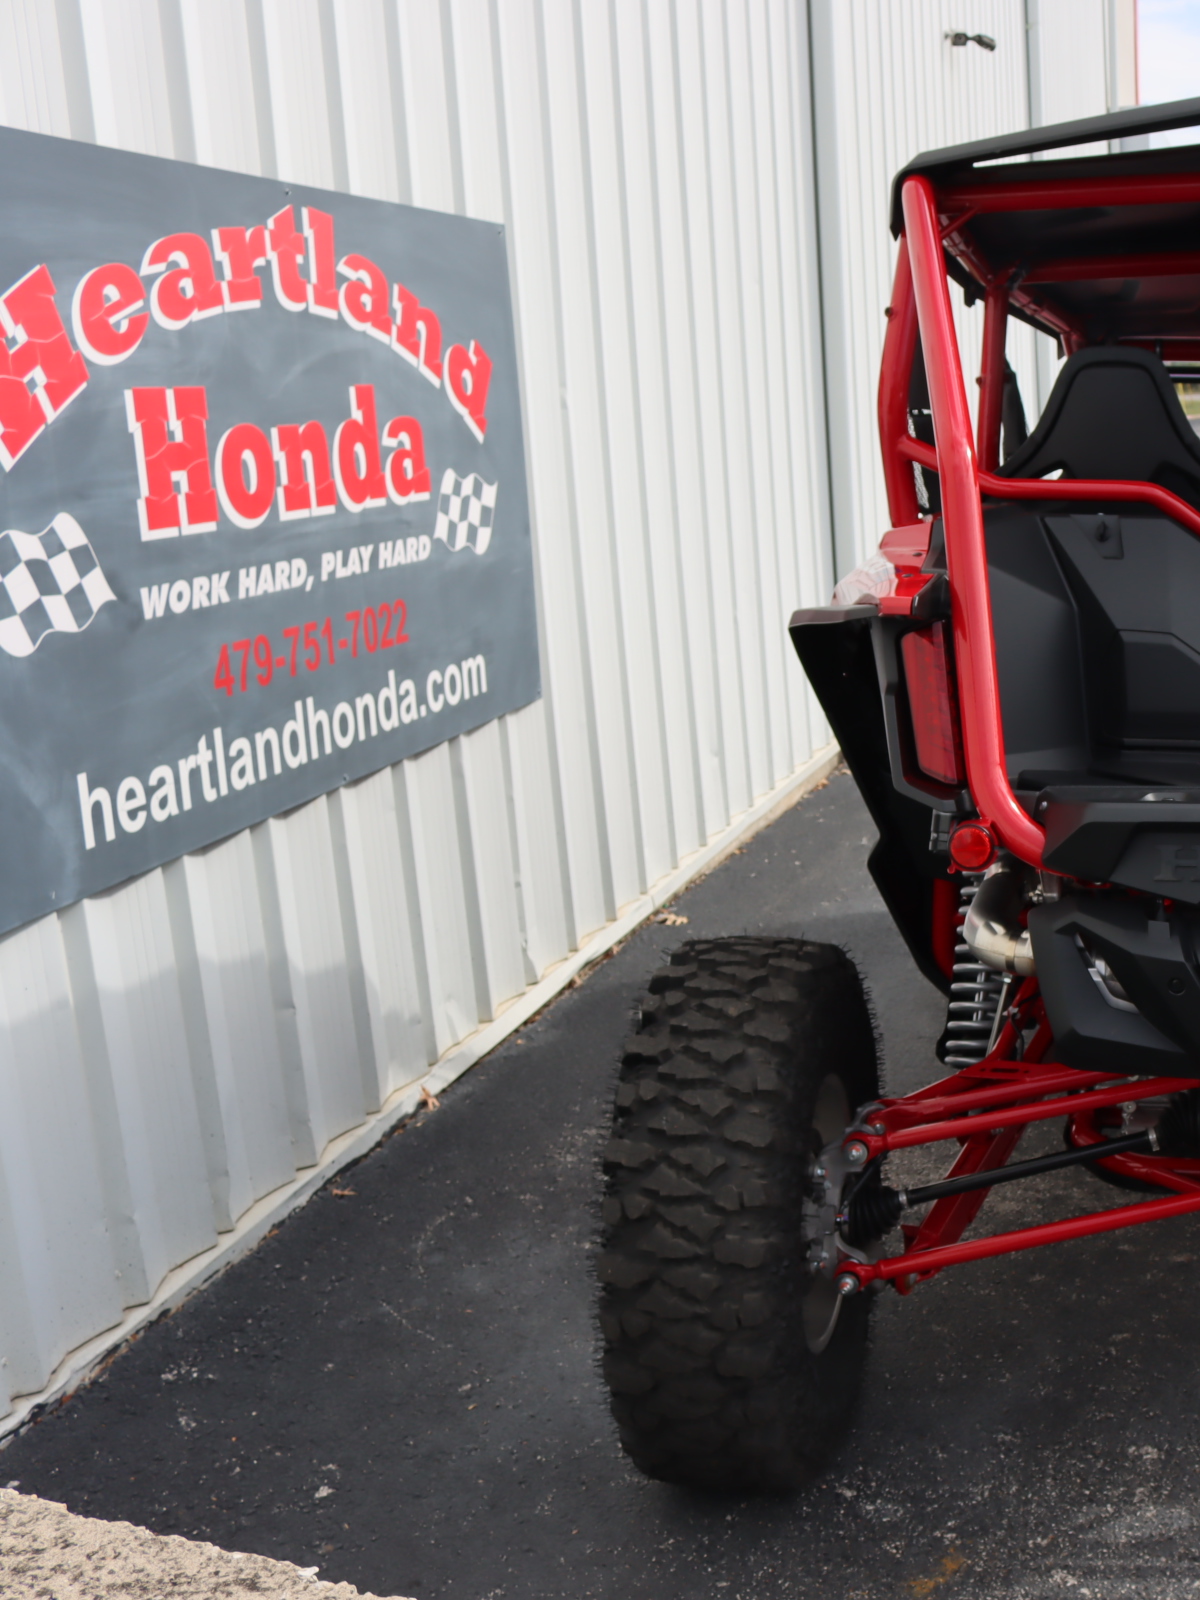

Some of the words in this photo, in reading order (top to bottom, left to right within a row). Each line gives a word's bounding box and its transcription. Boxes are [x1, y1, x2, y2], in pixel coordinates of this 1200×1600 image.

[0, 204, 493, 473] Heartland
[124, 383, 432, 541] Honda
[139, 573, 231, 620] WORK
[238, 557, 315, 600] HARD,
[321, 544, 374, 581] PLAY
[378, 534, 432, 569] HARD
[213, 598, 411, 698] 479-751-7022
[76, 653, 489, 851] heartlandhonda.com
